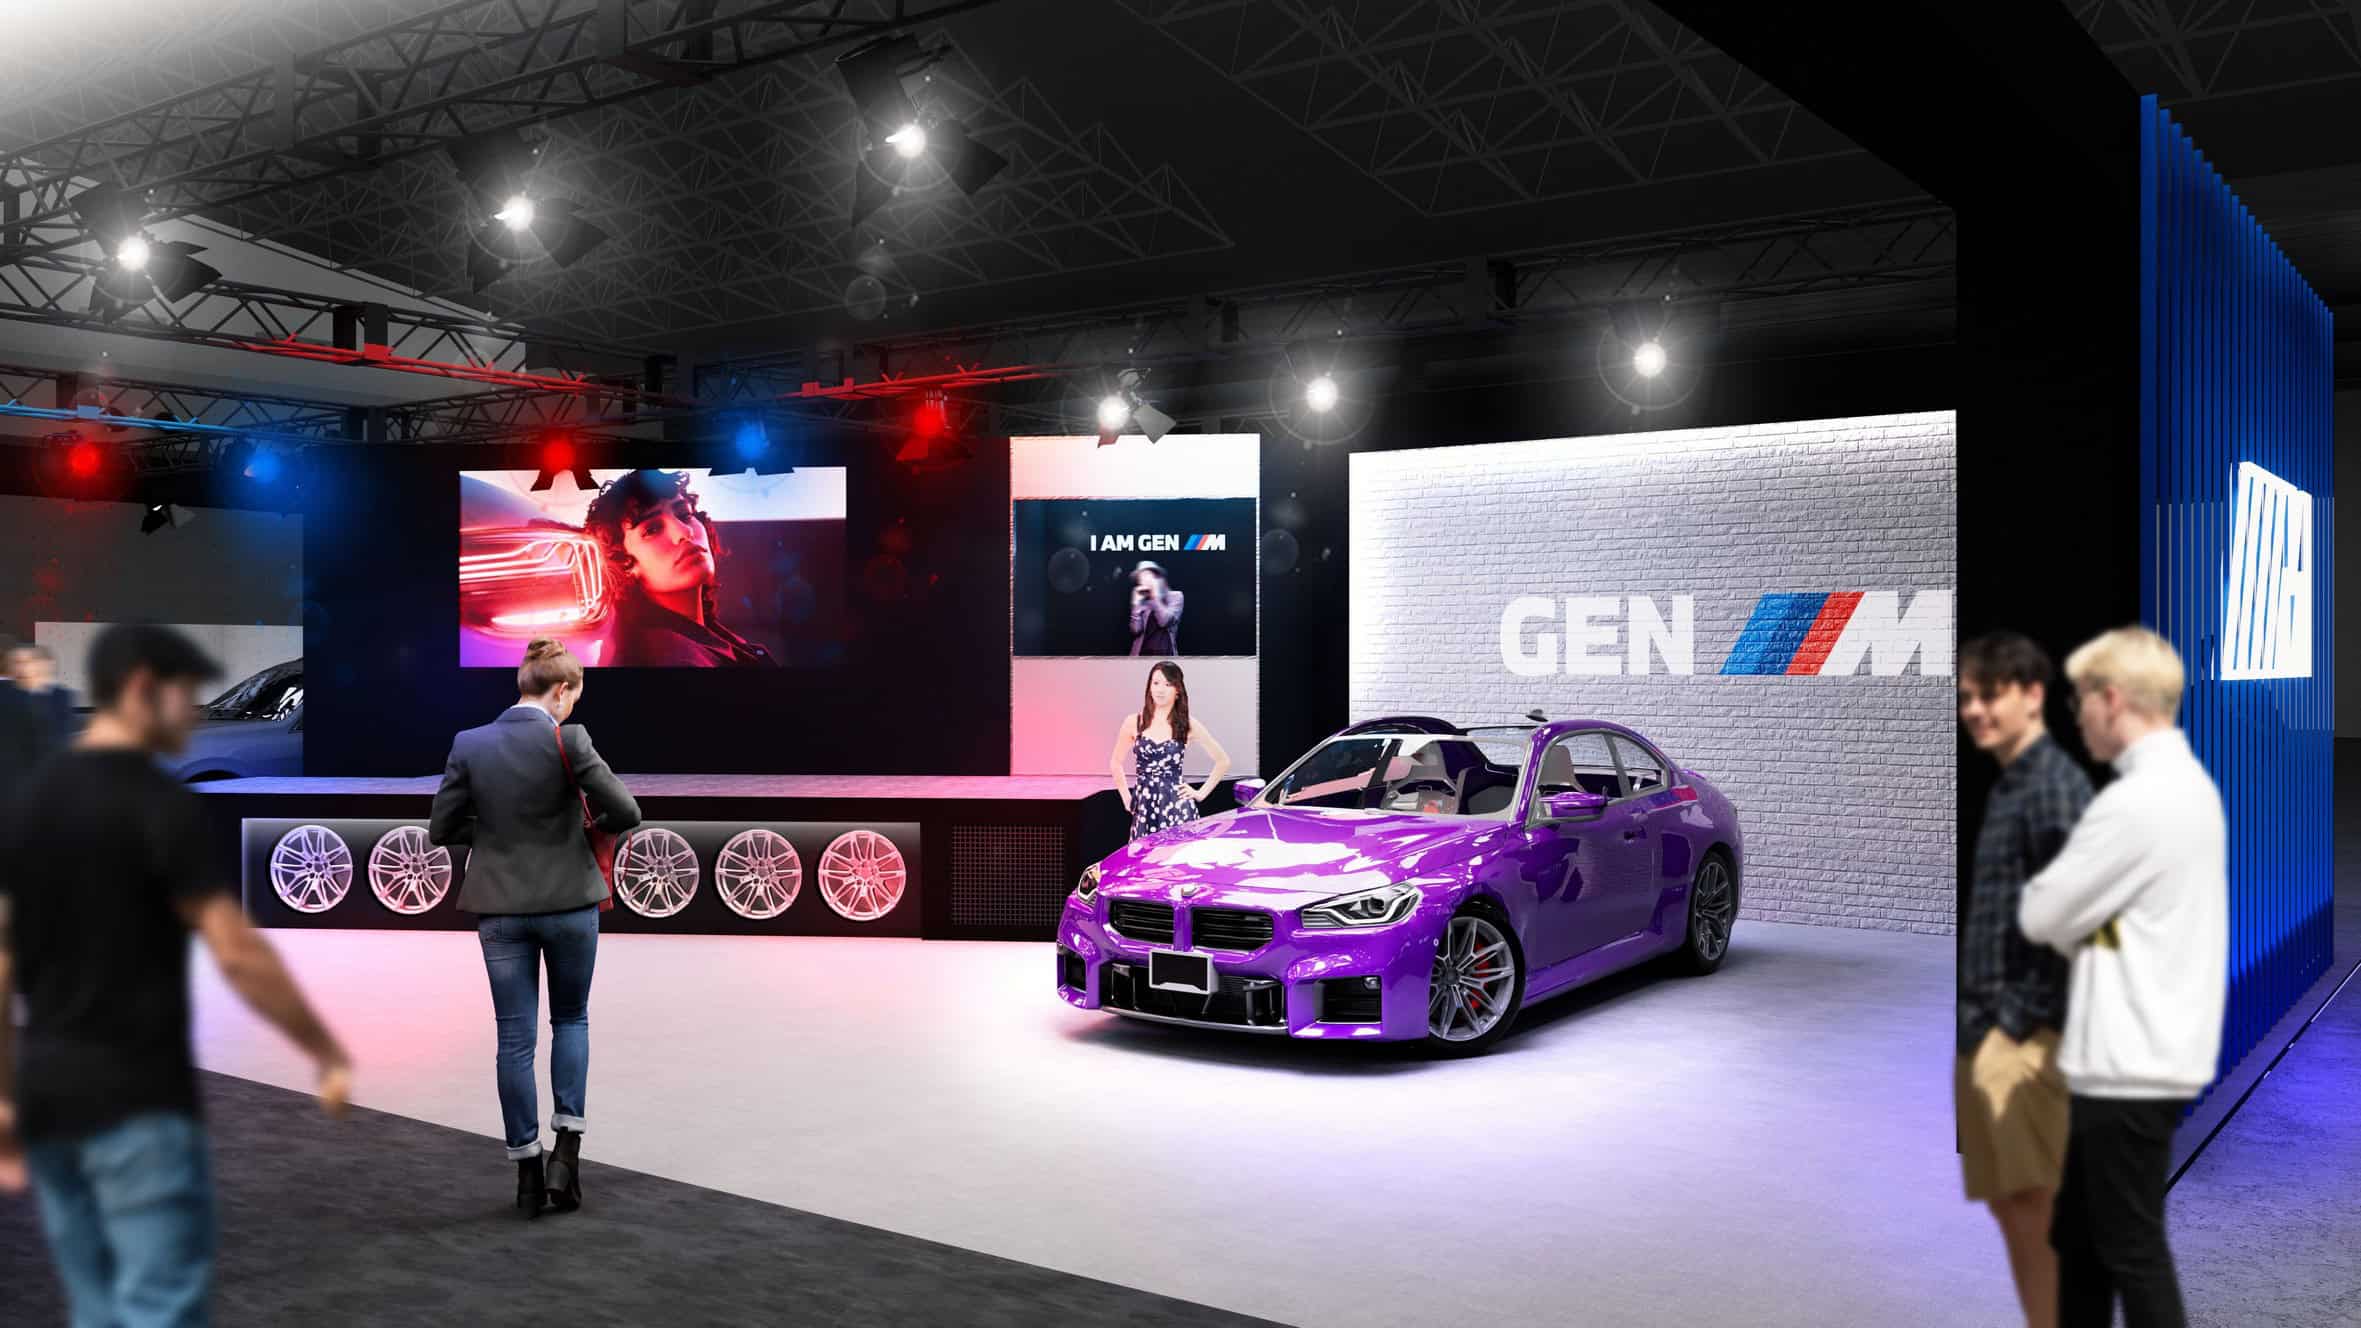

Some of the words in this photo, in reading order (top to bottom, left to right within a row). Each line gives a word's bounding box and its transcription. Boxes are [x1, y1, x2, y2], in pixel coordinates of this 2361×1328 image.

[1090, 534, 1097, 551] I
[1101, 534, 1134, 551] AM
[1138, 534, 1179, 551] GEN
[1200, 534, 1226, 550] M
[1499, 594, 1695, 676] GEN
[1817, 590, 1953, 676] M
